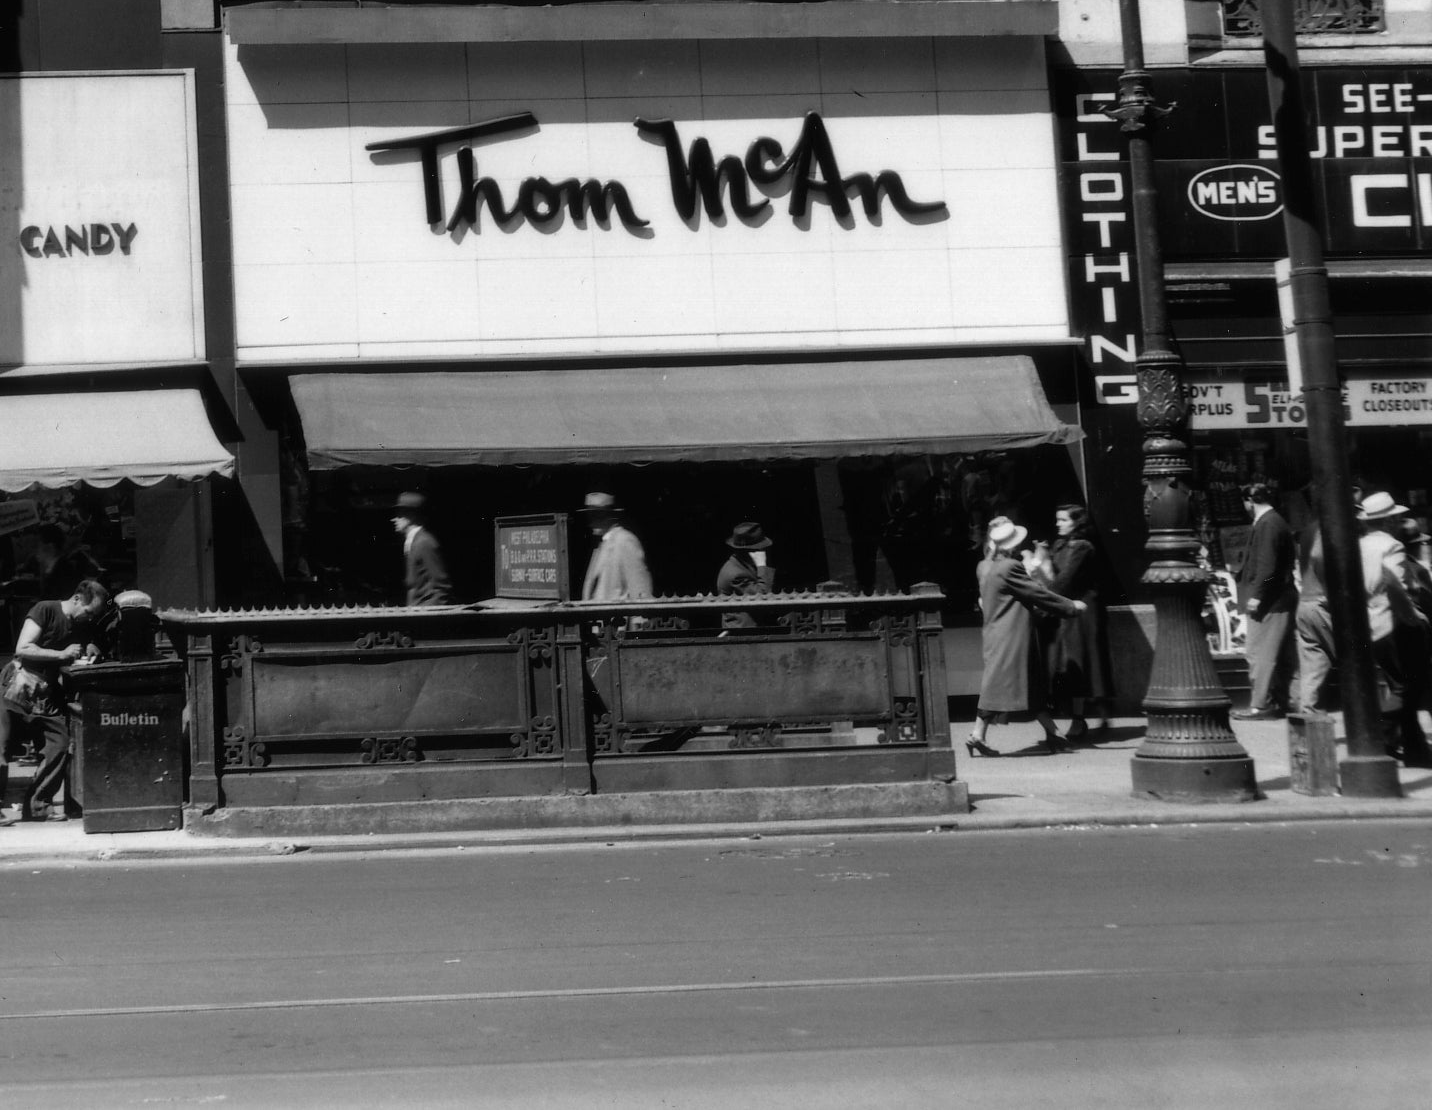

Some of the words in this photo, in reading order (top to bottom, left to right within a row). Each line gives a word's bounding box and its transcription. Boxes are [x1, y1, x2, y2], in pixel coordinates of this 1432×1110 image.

[365, 111, 650, 233] Thom
[633, 110, 947, 223] McAn
[1196, 176, 1276, 205] MEN'S
[20, 222, 138, 259] CANDY
[1076, 92, 1139, 405] CLOTHING
[1371, 381, 1427, 394] FACTORY
[1188, 403, 1234, 416] RPLUS
[100, 712, 159, 726] Bulletin
